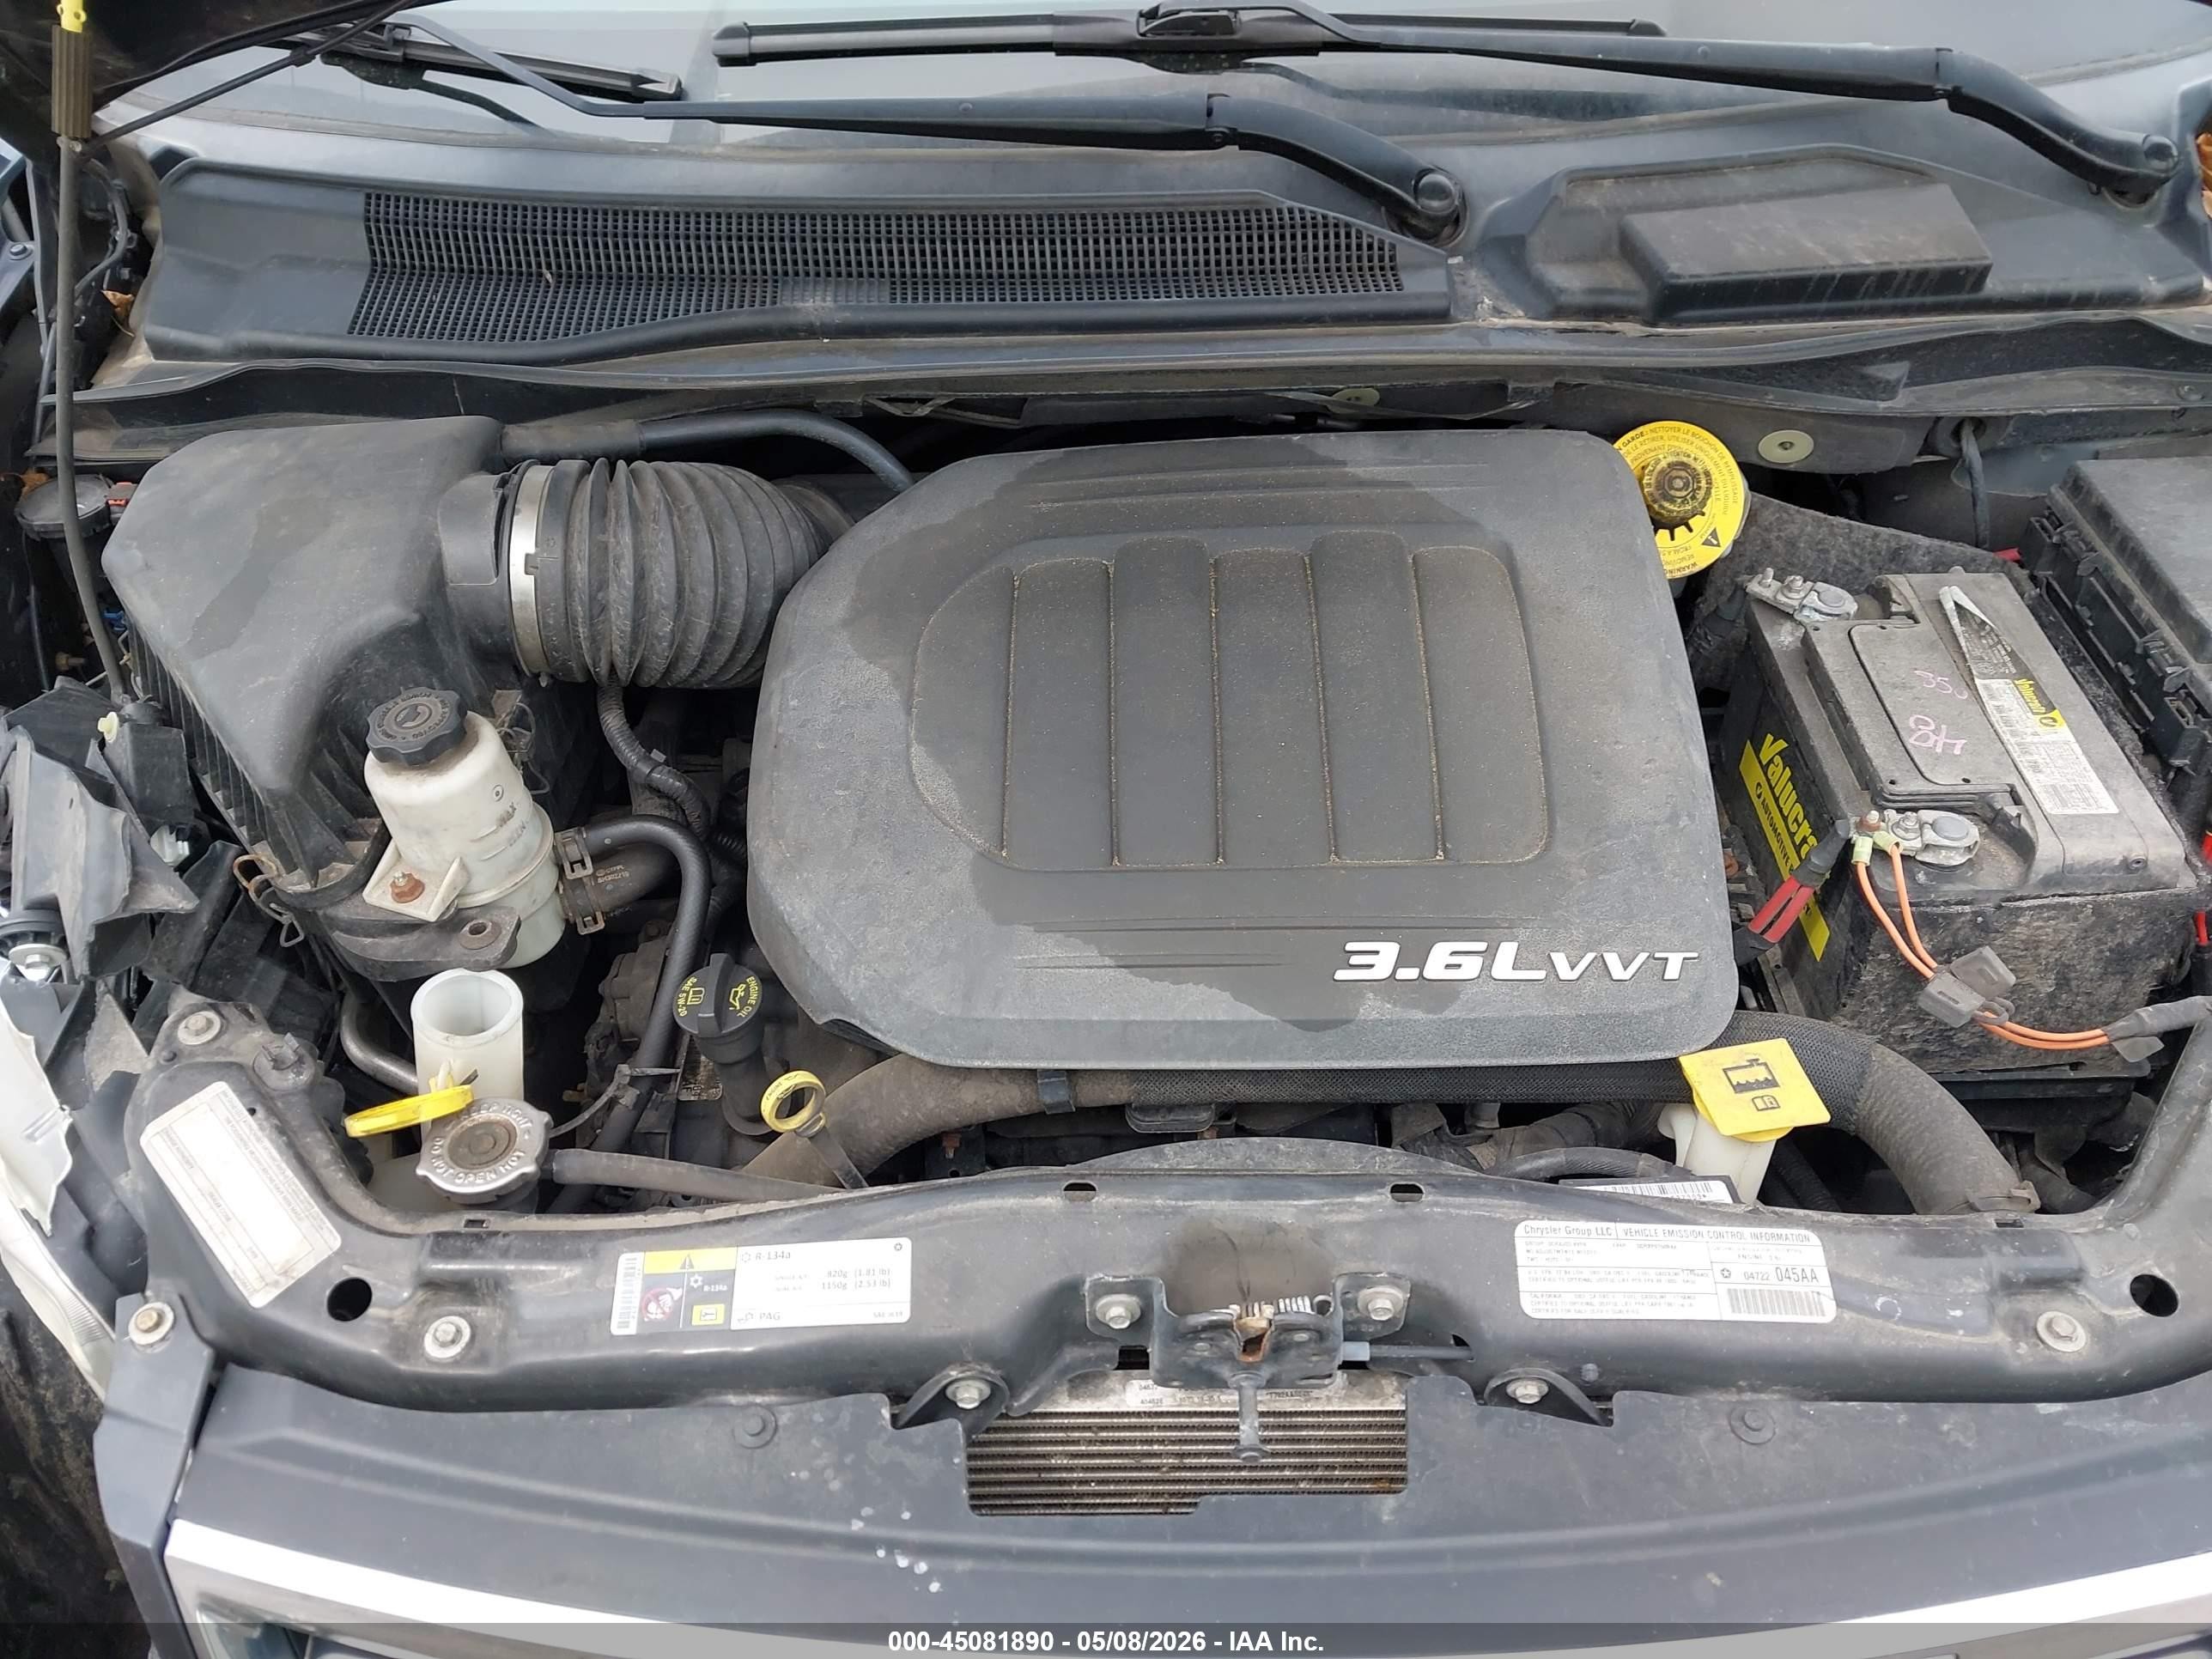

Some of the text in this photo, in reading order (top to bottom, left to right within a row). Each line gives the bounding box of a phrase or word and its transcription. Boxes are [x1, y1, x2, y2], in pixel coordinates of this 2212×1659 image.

[1662, 554, 1695, 566] REMOVIN
[1760, 798, 1791, 869] AUTOMOTIVE
[1334, 941, 1699, 981] 3.6L VVT
[682, 976, 697, 992] SAE
[737, 975, 759, 1018] ENGINE OIL
[430, 1137, 526, 1184] DO NOT OPEN HOT
[1523, 1224, 1811, 1244] Chrysler Group LLC VEHICLE EMISSION CONTROL INFORMATION
[755, 1250, 792, 1261] R-134a
[1743, 1267, 1820, 1285] 04722 045AA
[759, 1311, 781, 1322] PAG
